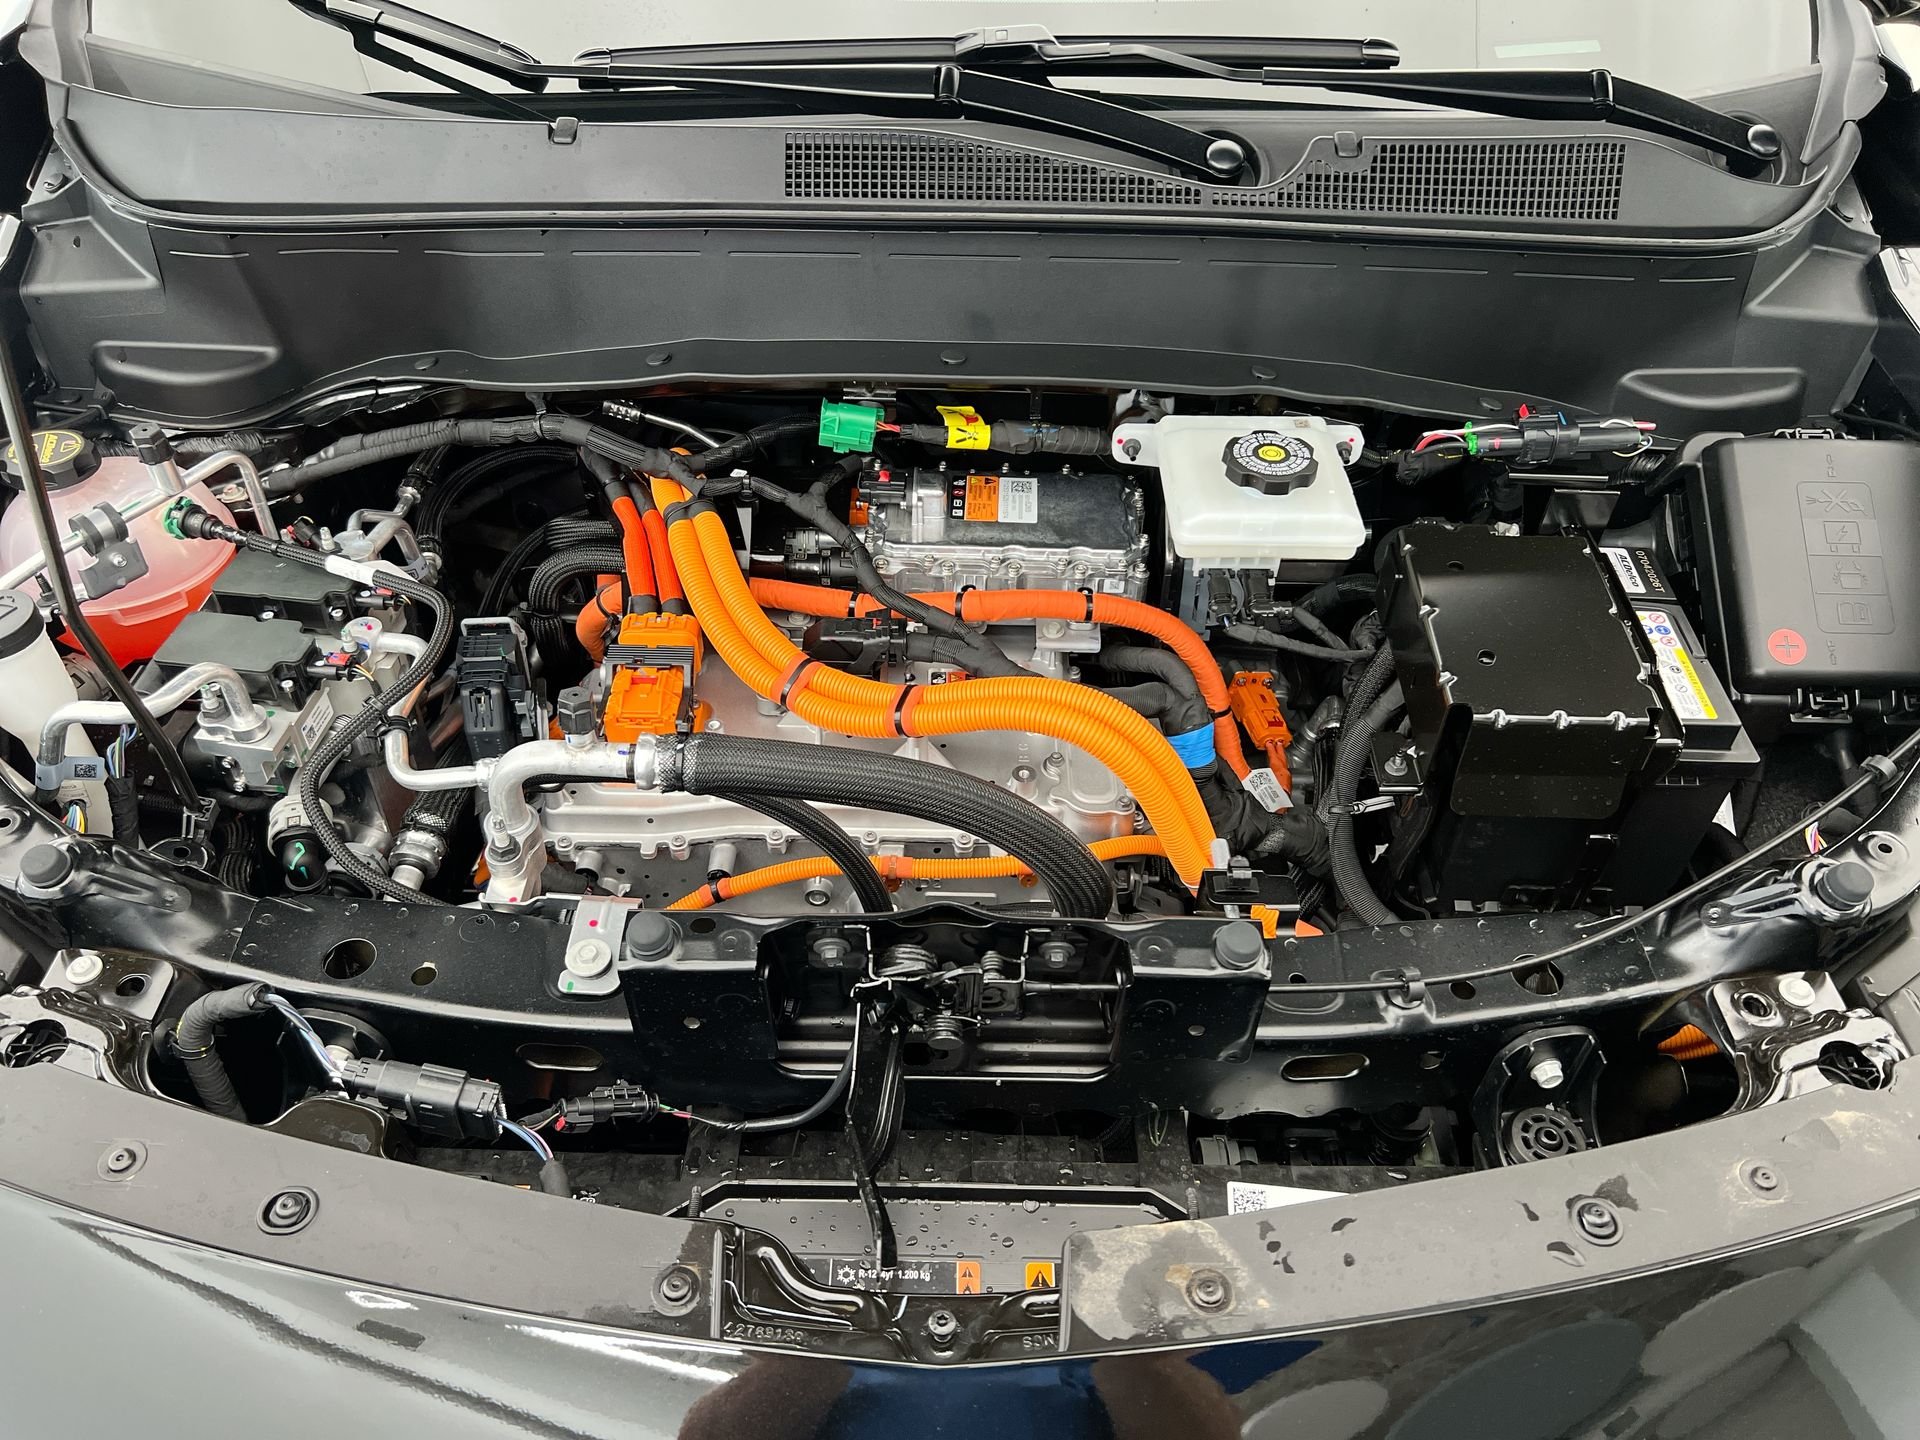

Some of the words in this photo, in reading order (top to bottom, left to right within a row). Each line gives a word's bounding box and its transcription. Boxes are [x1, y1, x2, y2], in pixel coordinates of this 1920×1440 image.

[1618, 553, 1639, 587] ACDelco
[1635, 550, 1666, 593] 07042026T
[858, 1269, 893, 1280] R-124yf
[897, 1270, 918, 1280] 1.200
[919, 1270, 930, 1282] kg
